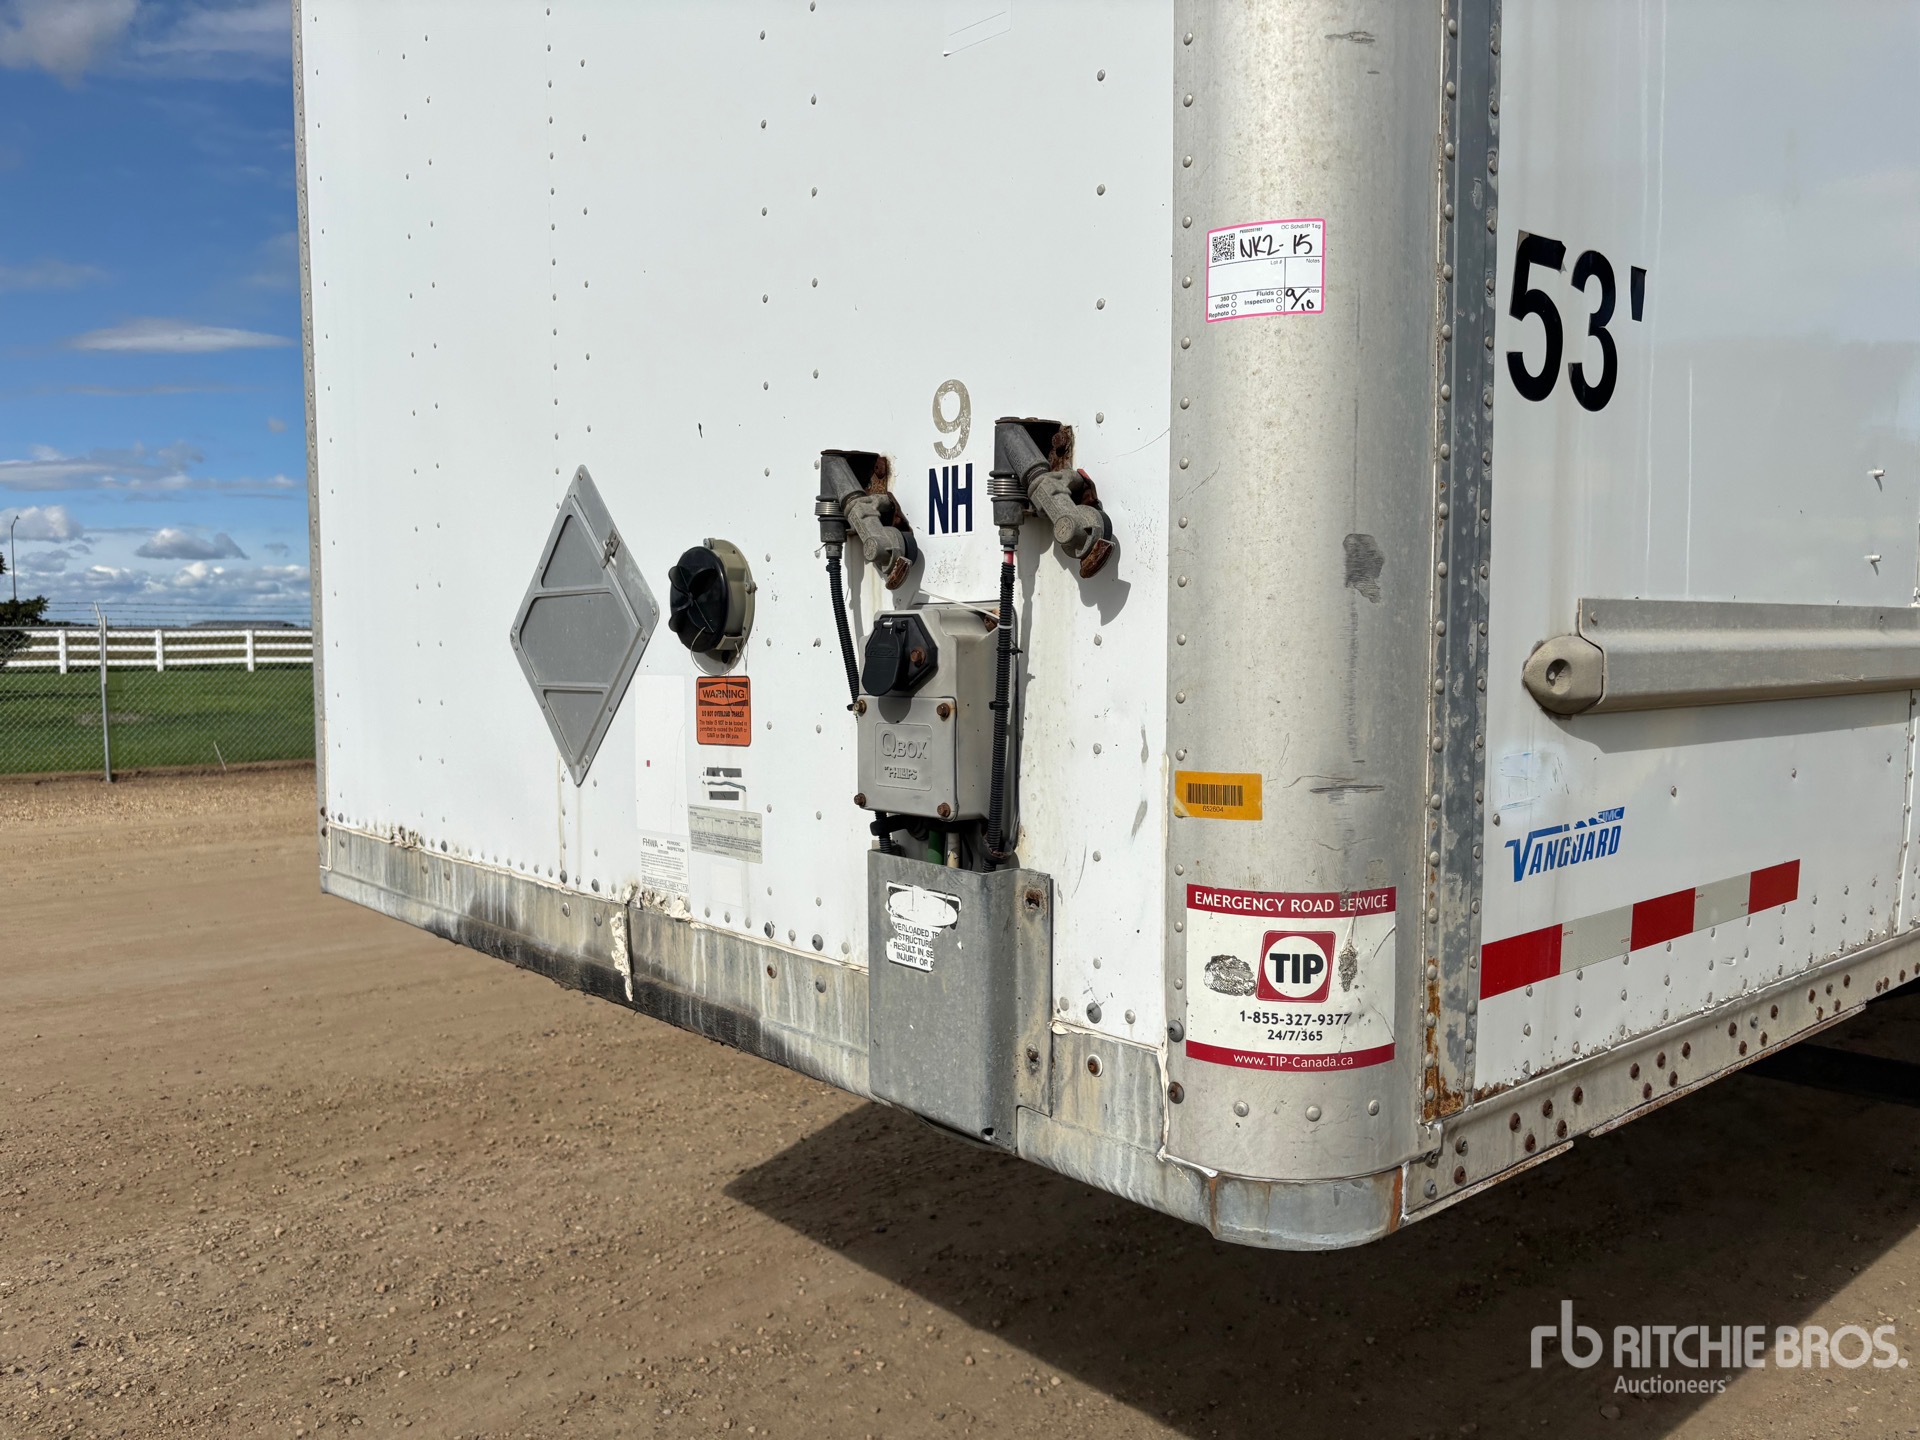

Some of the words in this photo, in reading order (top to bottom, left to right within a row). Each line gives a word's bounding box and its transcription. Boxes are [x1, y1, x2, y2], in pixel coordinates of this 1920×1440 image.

[1215, 302, 1230, 310] Video
[1244, 298, 1275, 306] Inspection
[932, 379, 972, 460] 9
[928, 463, 973, 535] NH
[702, 689, 745, 699] WARNING
[642, 837, 658, 848] FHWA
[1504, 825, 1622, 882] VANGUARD
[1195, 891, 1285, 913] EMERGENCY
[1290, 899, 1335, 913] ROAD
[1339, 894, 1389, 912] SERVICE
[892, 921, 930, 938] VERLOADED
[893, 941, 916, 955] RESULT
[917, 948, 924, 957] IN
[896, 951, 918, 964] INJURY
[919, 958, 928, 967] OR
[1269, 952, 1323, 984] TIP
[1240, 1010, 1351, 1027] 1-855-327-9377
[1267, 1029, 1323, 1042] 24/7/365
[1233, 1053, 1354, 1069] www.TIP-Canada.ca
